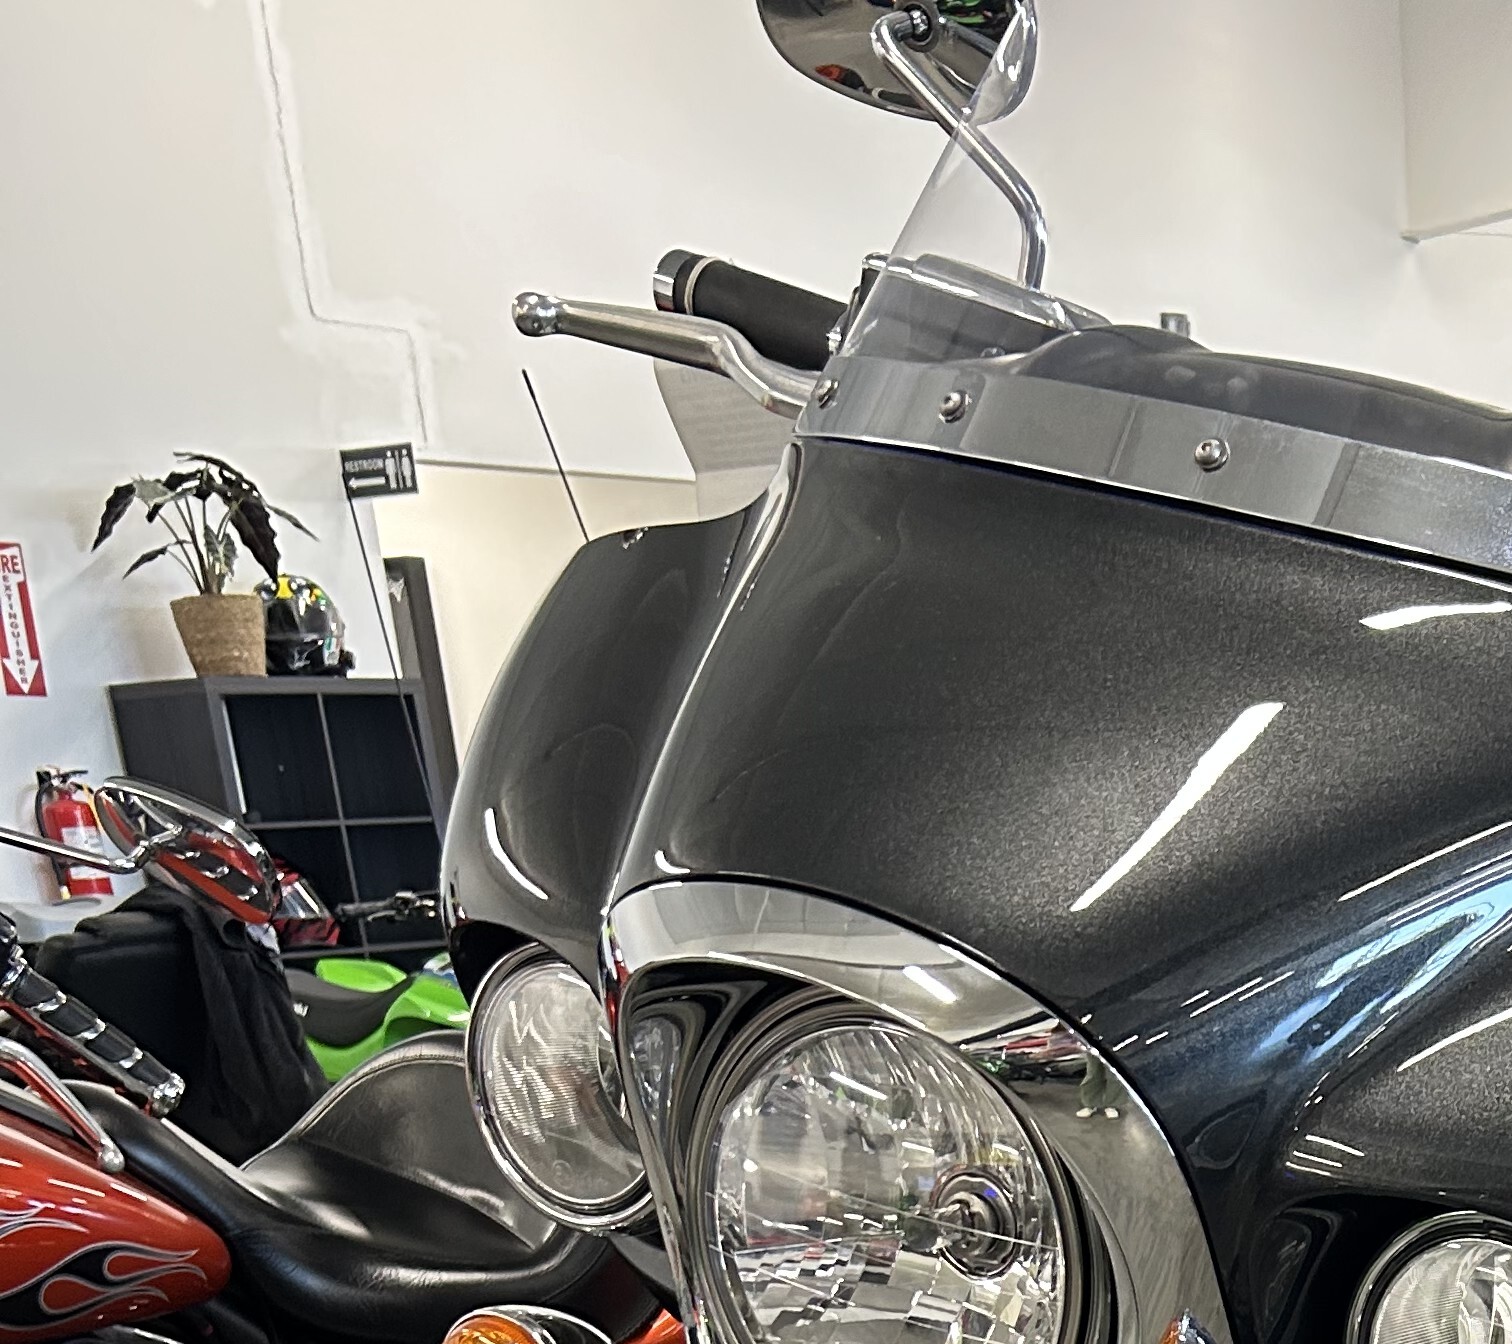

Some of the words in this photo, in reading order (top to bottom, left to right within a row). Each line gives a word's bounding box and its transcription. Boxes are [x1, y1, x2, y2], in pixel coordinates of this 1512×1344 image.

[344, 458, 384, 473] RESTROOM
[0, 554, 21, 574] RE
[2, 575, 28, 684] EXTINGUISHER
